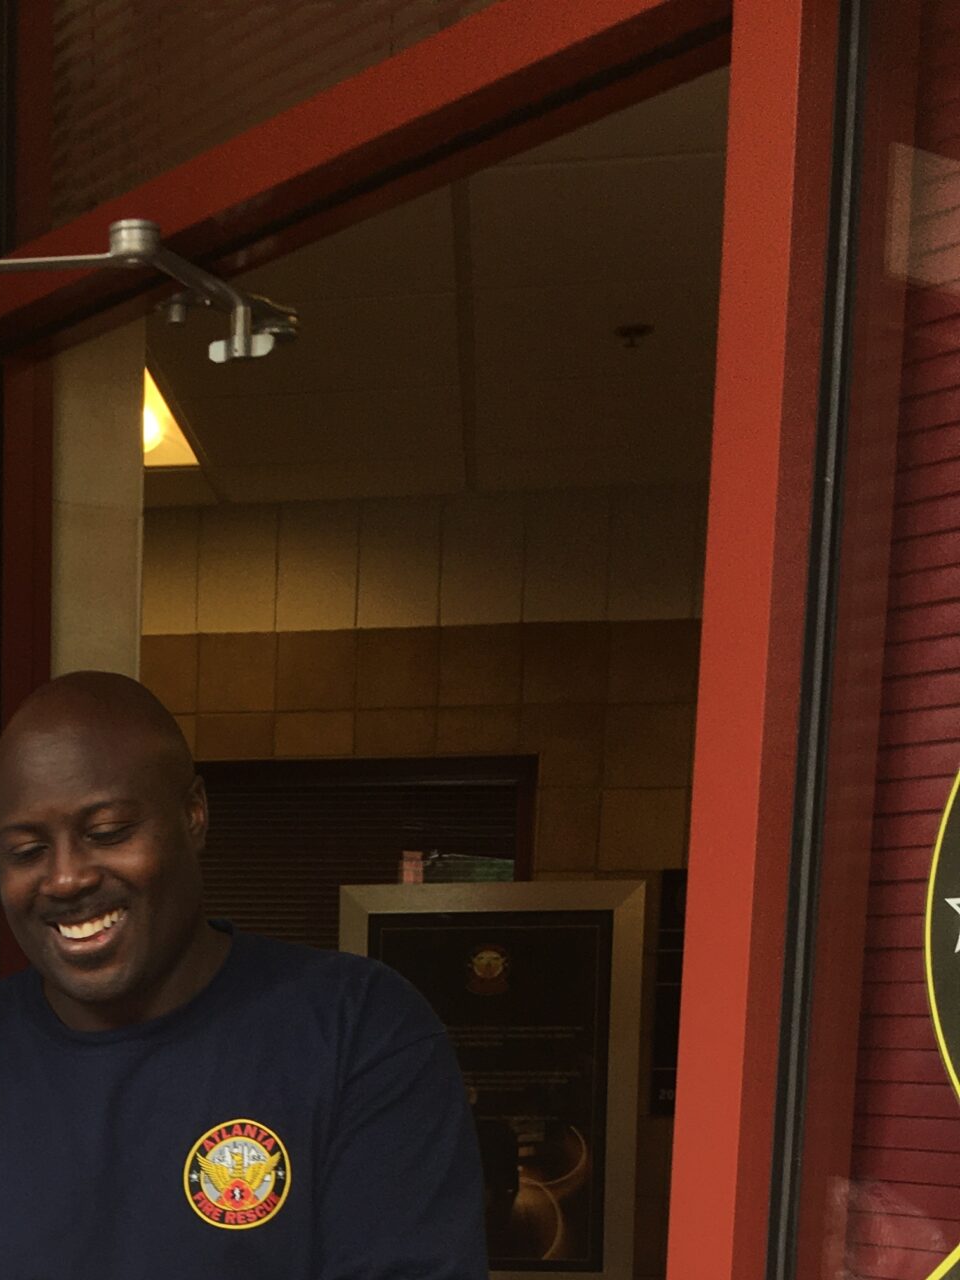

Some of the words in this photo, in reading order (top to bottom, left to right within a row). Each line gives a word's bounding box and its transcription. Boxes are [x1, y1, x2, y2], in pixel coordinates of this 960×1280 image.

[203, 1124, 276, 1152] ATLANTA
[193, 1191, 224, 1221] FIRE
[225, 1192, 281, 1224] RESCUE
